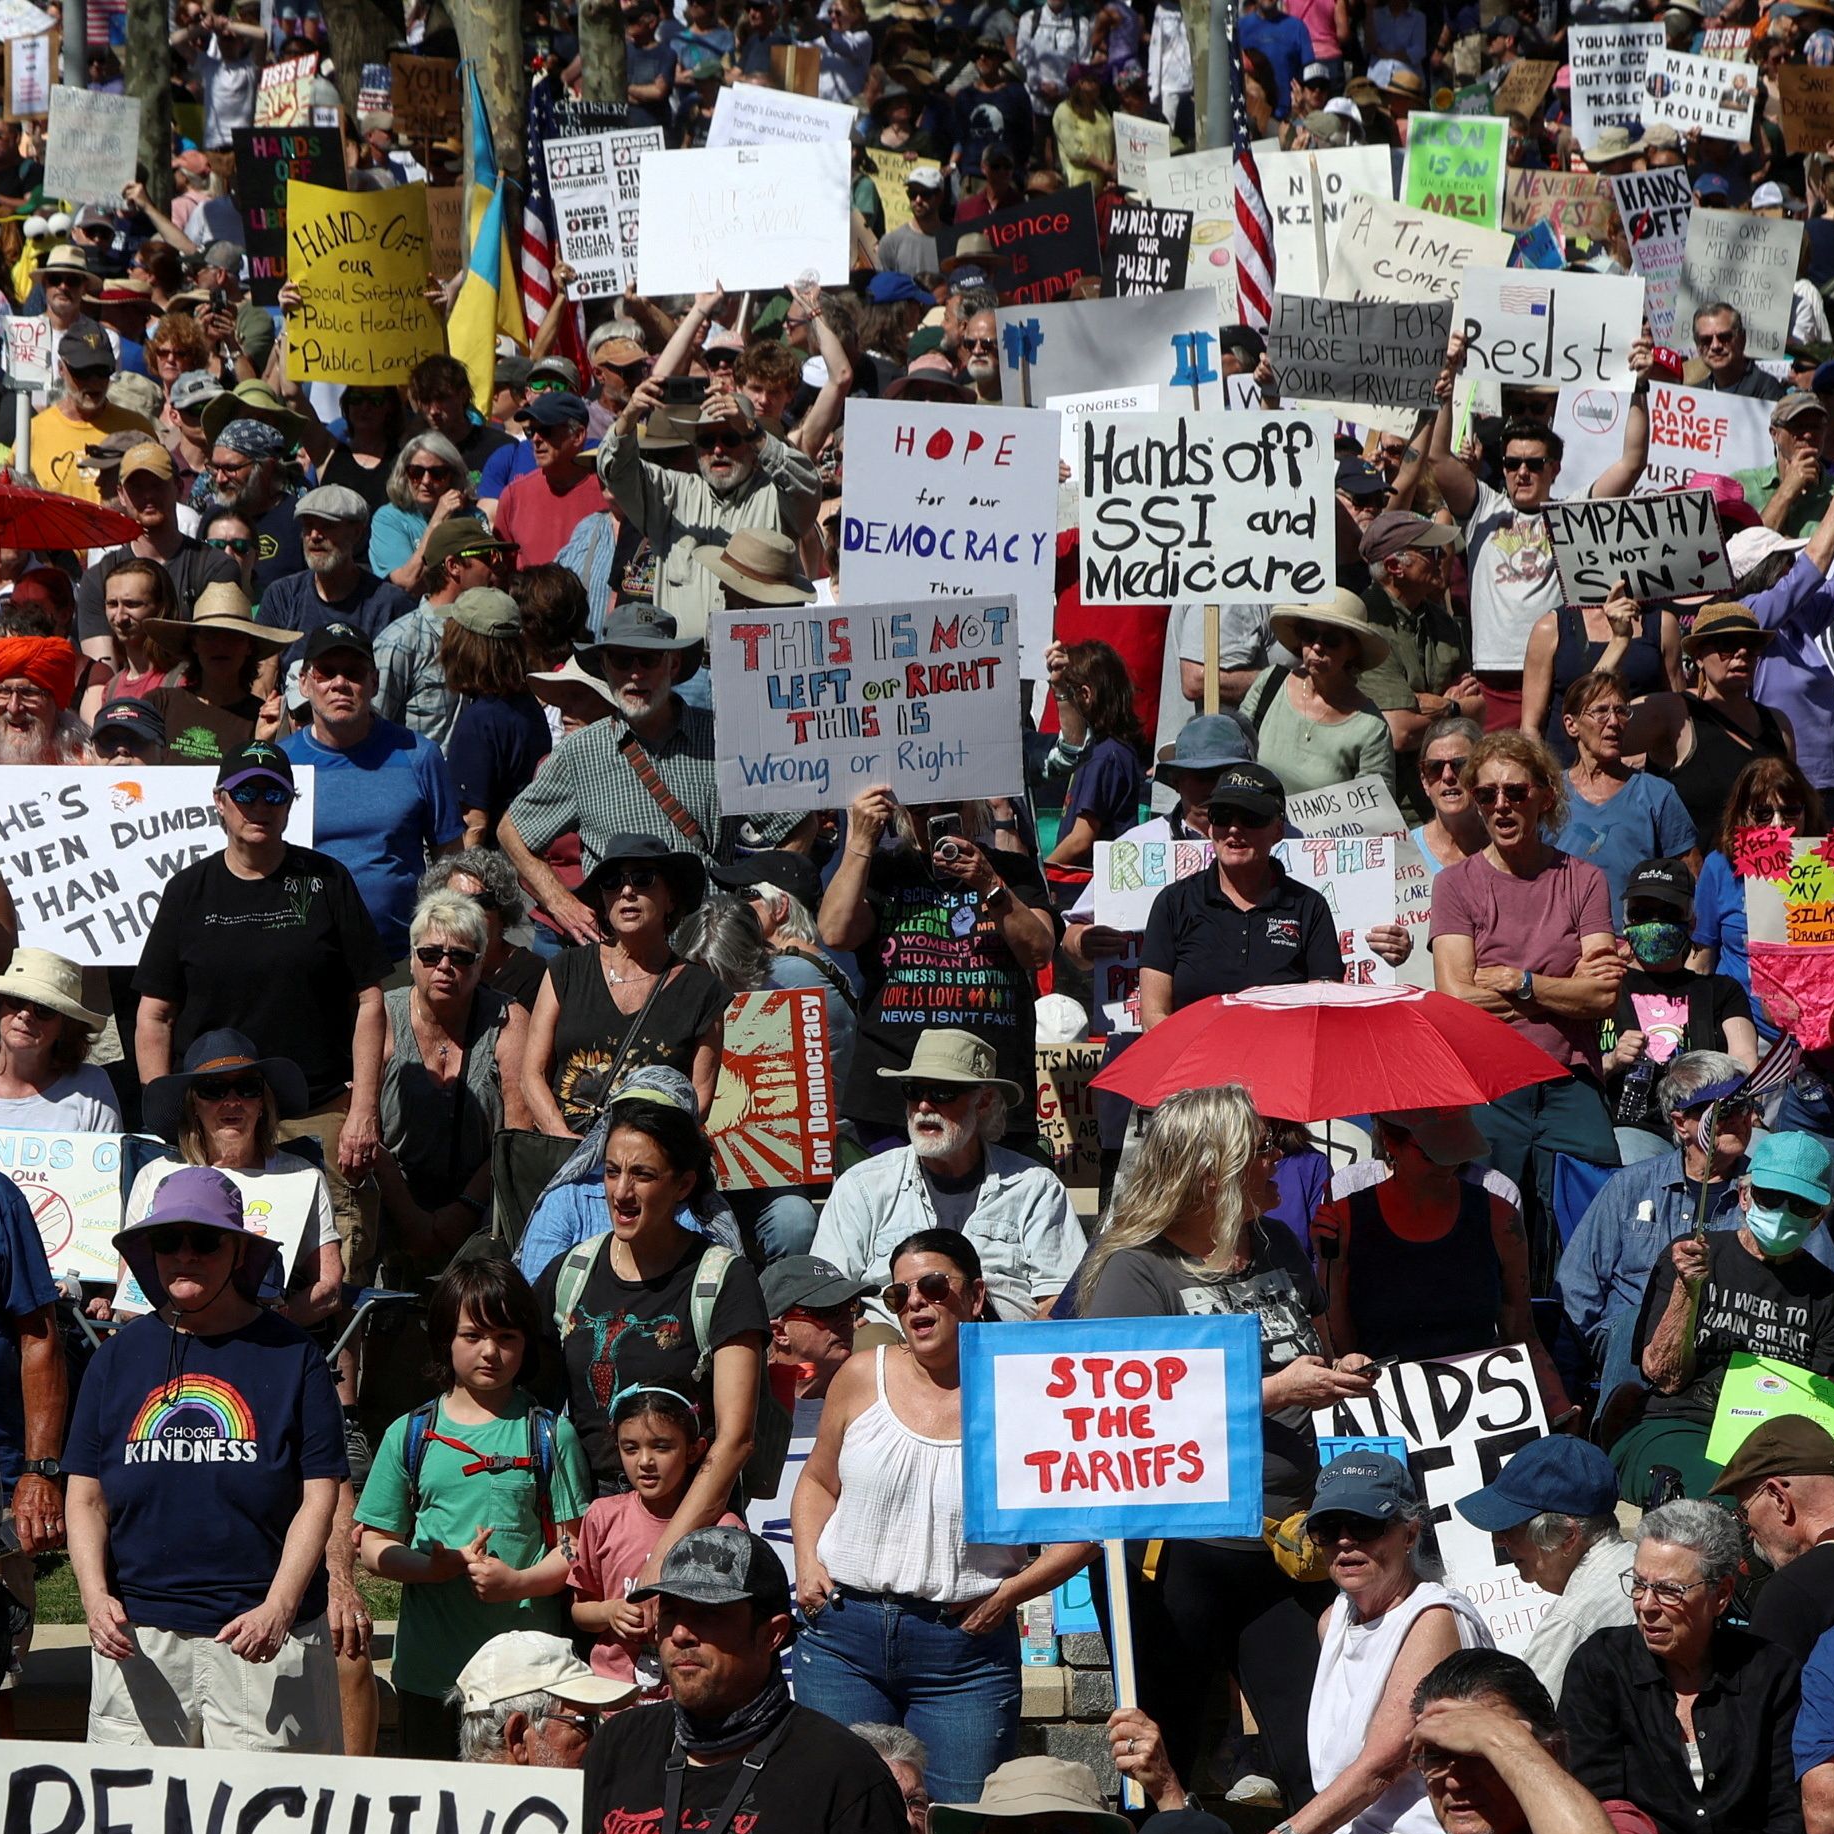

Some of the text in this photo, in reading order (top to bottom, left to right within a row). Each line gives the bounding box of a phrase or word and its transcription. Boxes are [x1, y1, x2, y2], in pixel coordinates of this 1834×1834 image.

[551, 177, 609, 191] IMMIGRANTS
[378, 215, 425, 253] OFF
[567, 234, 613, 248] SOCIAL
[1109, 212, 1188, 240] HANDS OFF
[568, 247, 615, 262] SECURITY
[1138, 237, 1160, 255] OUR
[340, 260, 373, 277] OUR
[1116, 255, 1171, 281] PUBLIC
[1656, 389, 1695, 413] NO
[895, 424, 1016, 467] HOPE
[1084, 416, 1313, 498] Hands off
[1651, 426, 1722, 458] KING!
[915, 489, 1000, 508] for our
[1093, 494, 1316, 550] SSI and
[1549, 491, 1716, 544] EMPATHY
[844, 517, 1047, 566] DEMOCRACY
[1578, 544, 1678, 566] IS NOT A
[1086, 548, 1325, 599] Medicare
[730, 607, 1008, 672] THIS IS NOT
[767, 657, 1001, 708] LEFT or RIGHT
[1046, 1357, 1187, 1400] STOP
[163, 1424, 216, 1439] CHOOSE
[1063, 1405, 1154, 1441] THE
[125, 1438, 257, 1466] KINDNESS
[1025, 1441, 1205, 1494] TARIFFS
